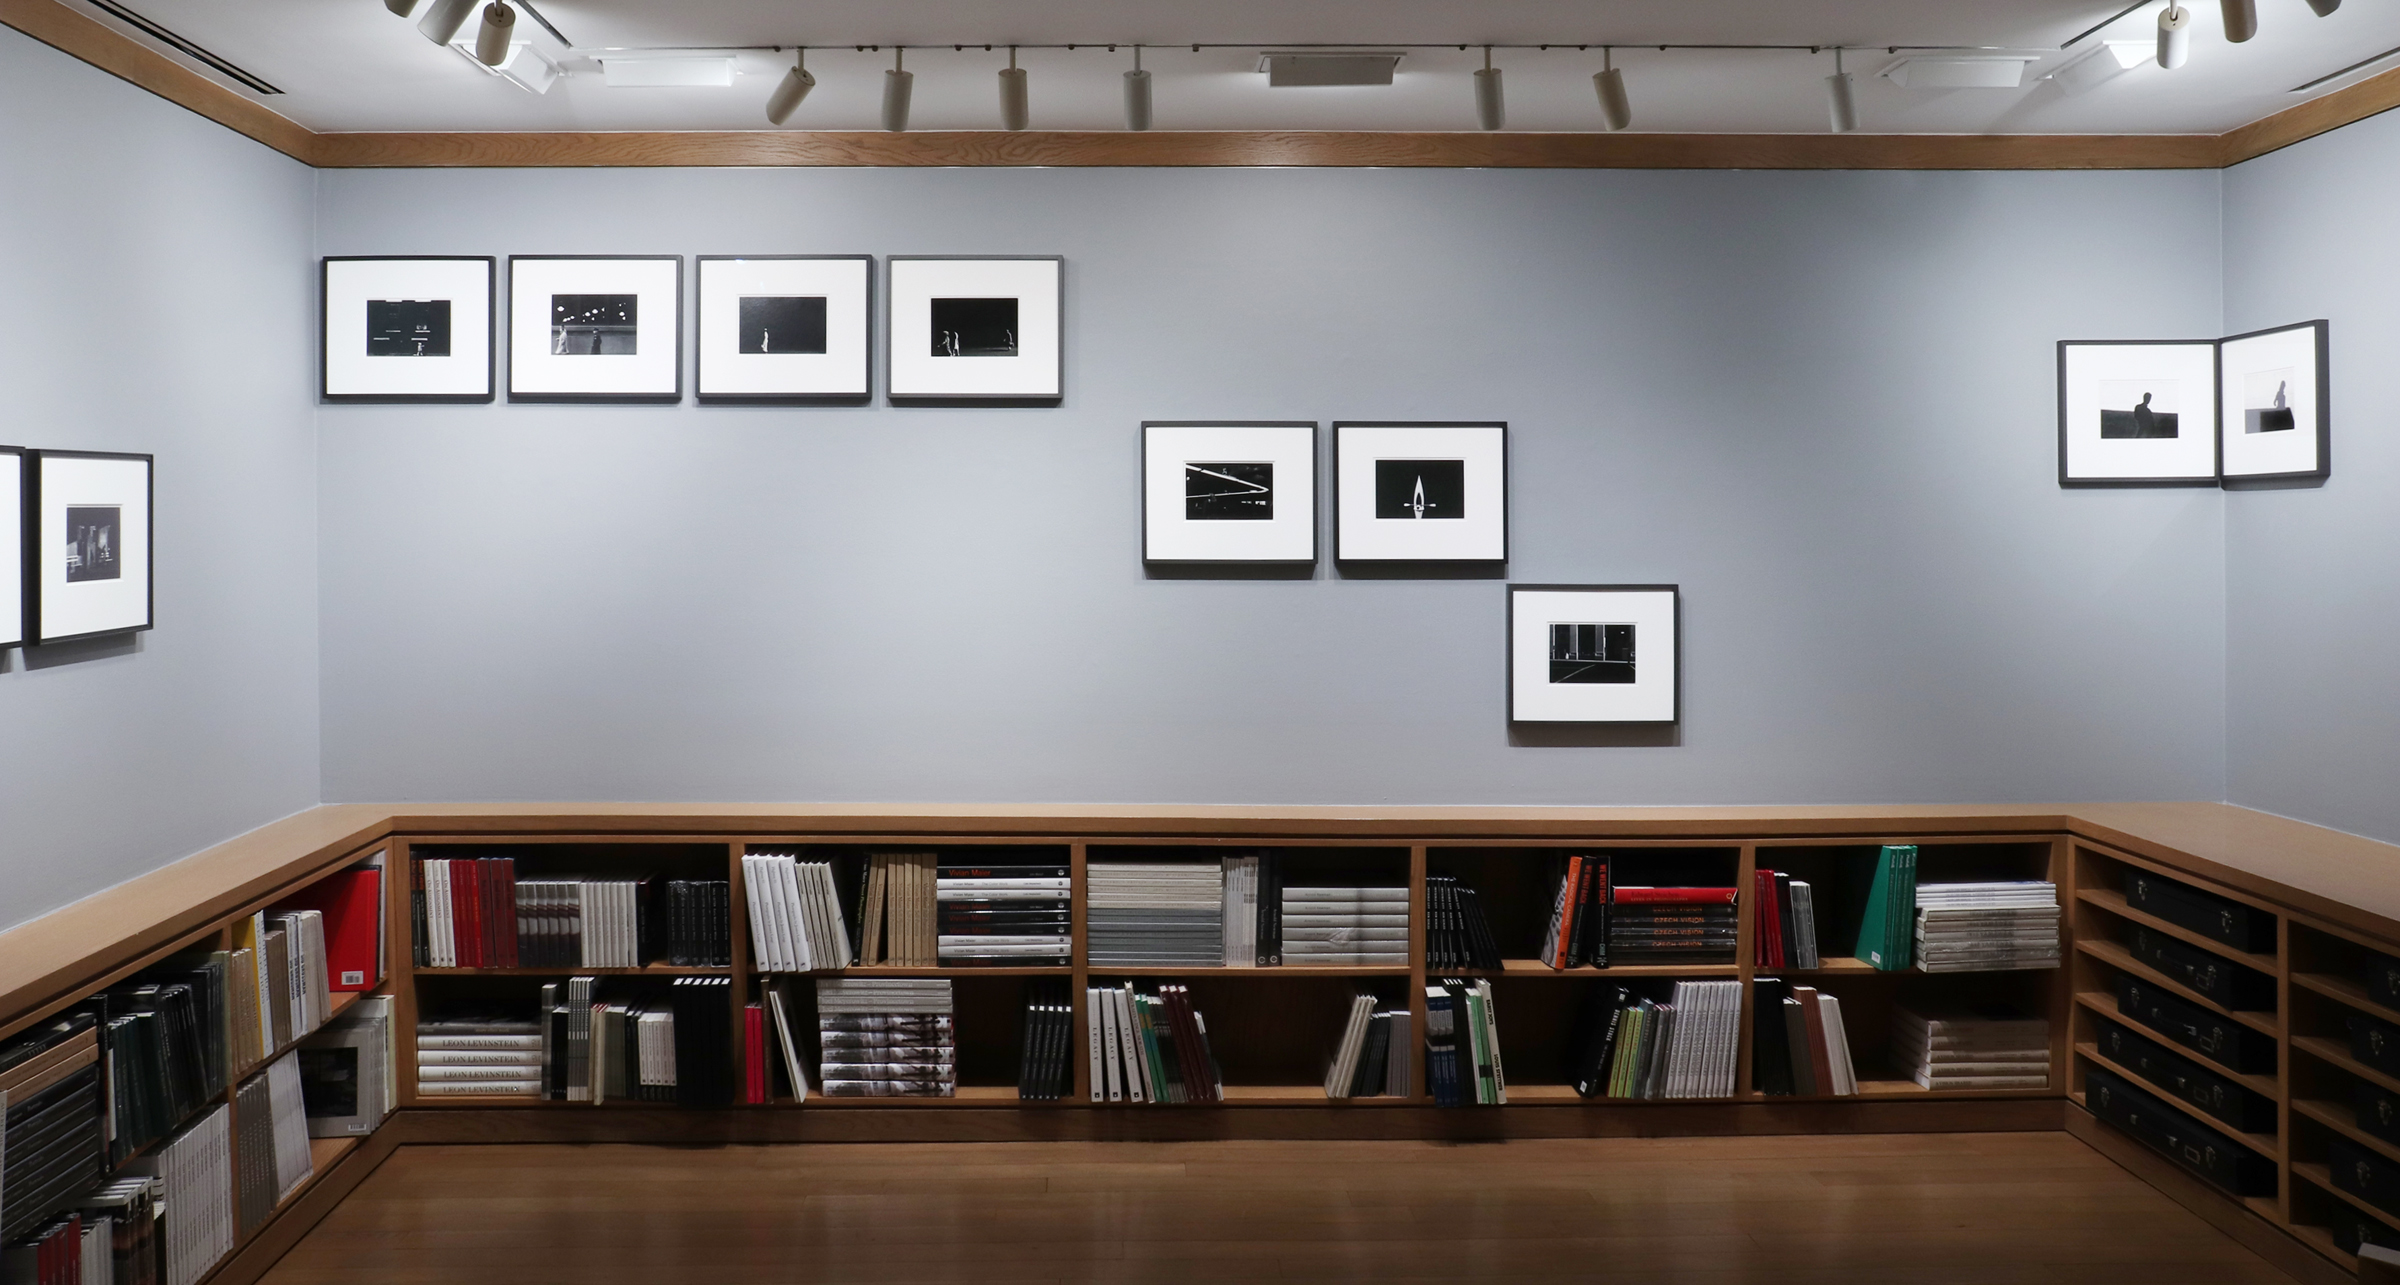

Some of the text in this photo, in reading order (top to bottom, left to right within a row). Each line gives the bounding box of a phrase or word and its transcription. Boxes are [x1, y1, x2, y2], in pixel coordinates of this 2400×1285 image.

[1585, 865, 1592, 873] WE
[1599, 864, 1606, 872] WE
[1582, 874, 1590, 889] WENT
[1579, 889, 1588, 904] BACK
[1606, 1009, 1620, 1042] DENNIS STOCK
[1124, 1027, 1132, 1061] LEGACY
